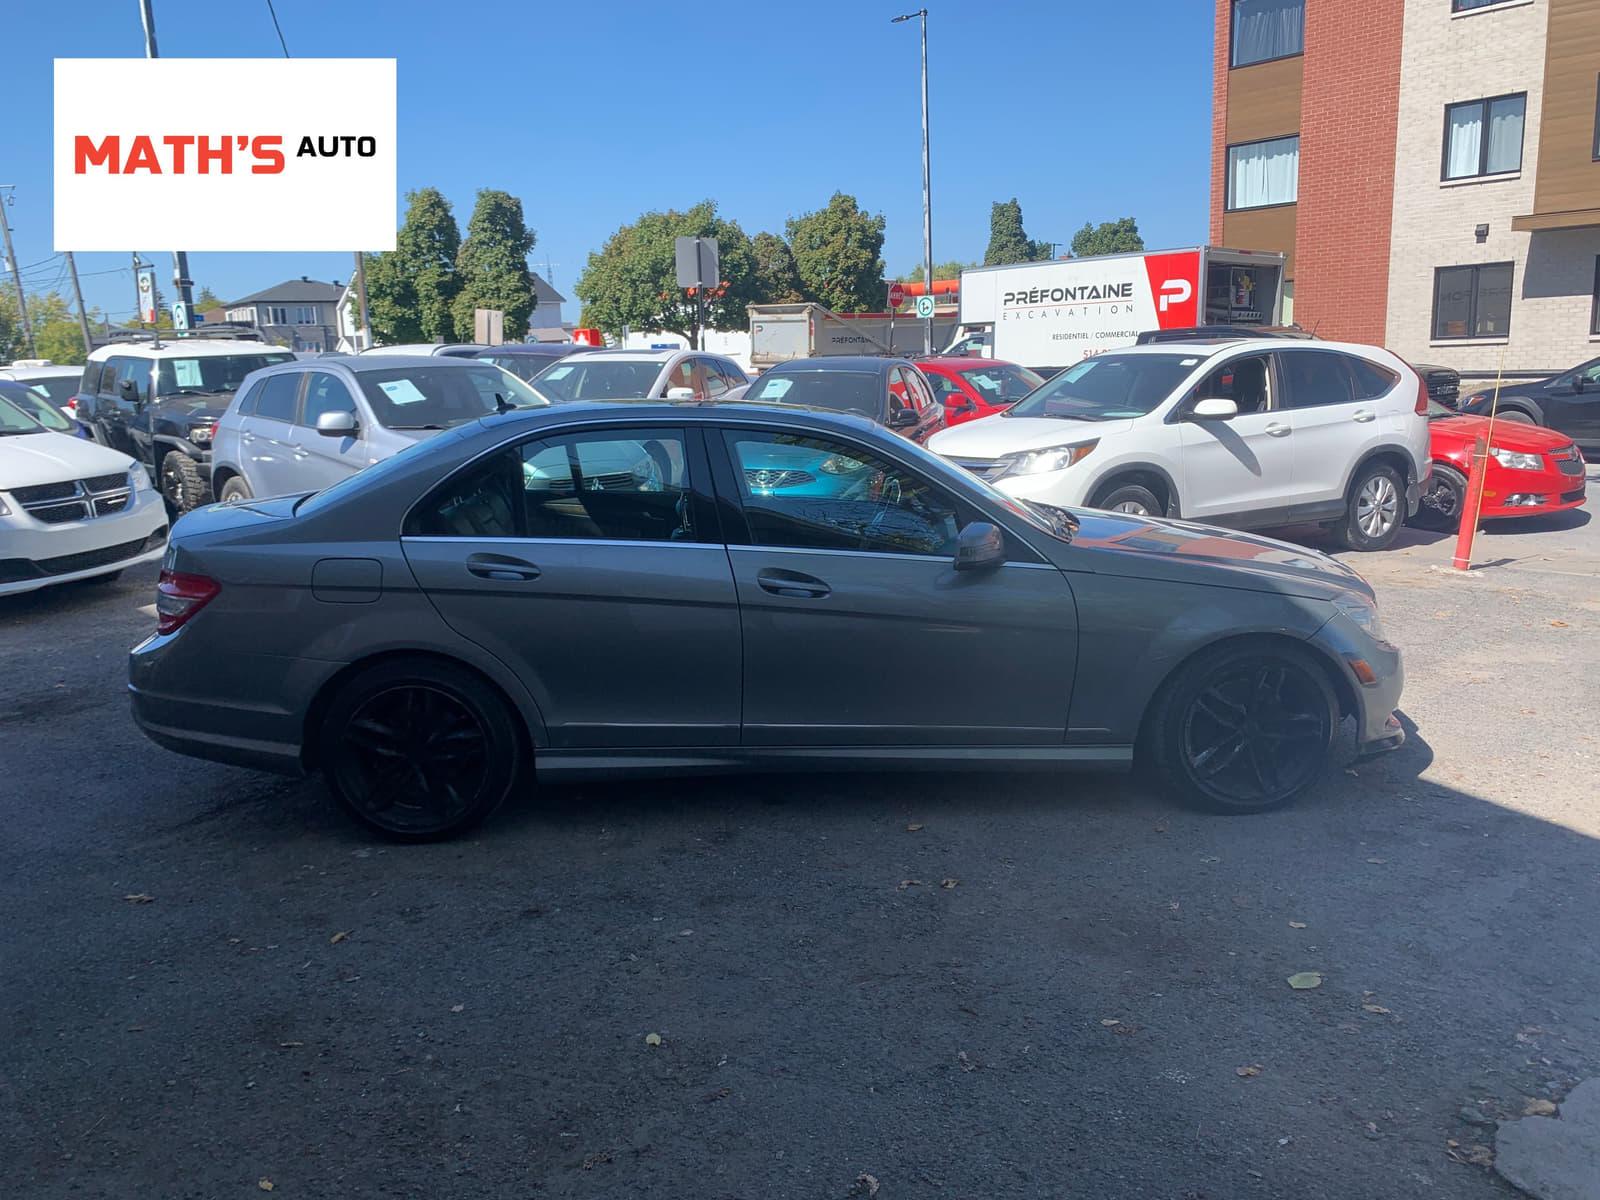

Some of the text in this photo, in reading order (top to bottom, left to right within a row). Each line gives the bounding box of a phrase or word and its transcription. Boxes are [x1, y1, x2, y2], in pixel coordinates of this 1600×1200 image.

[1003, 282, 1133, 306] PRÉFONTAINE
[1159, 278, 1192, 312] P
[1003, 304, 1133, 320] EXCAVATION
[1095, 330, 1138, 340] COMMERCIAL
